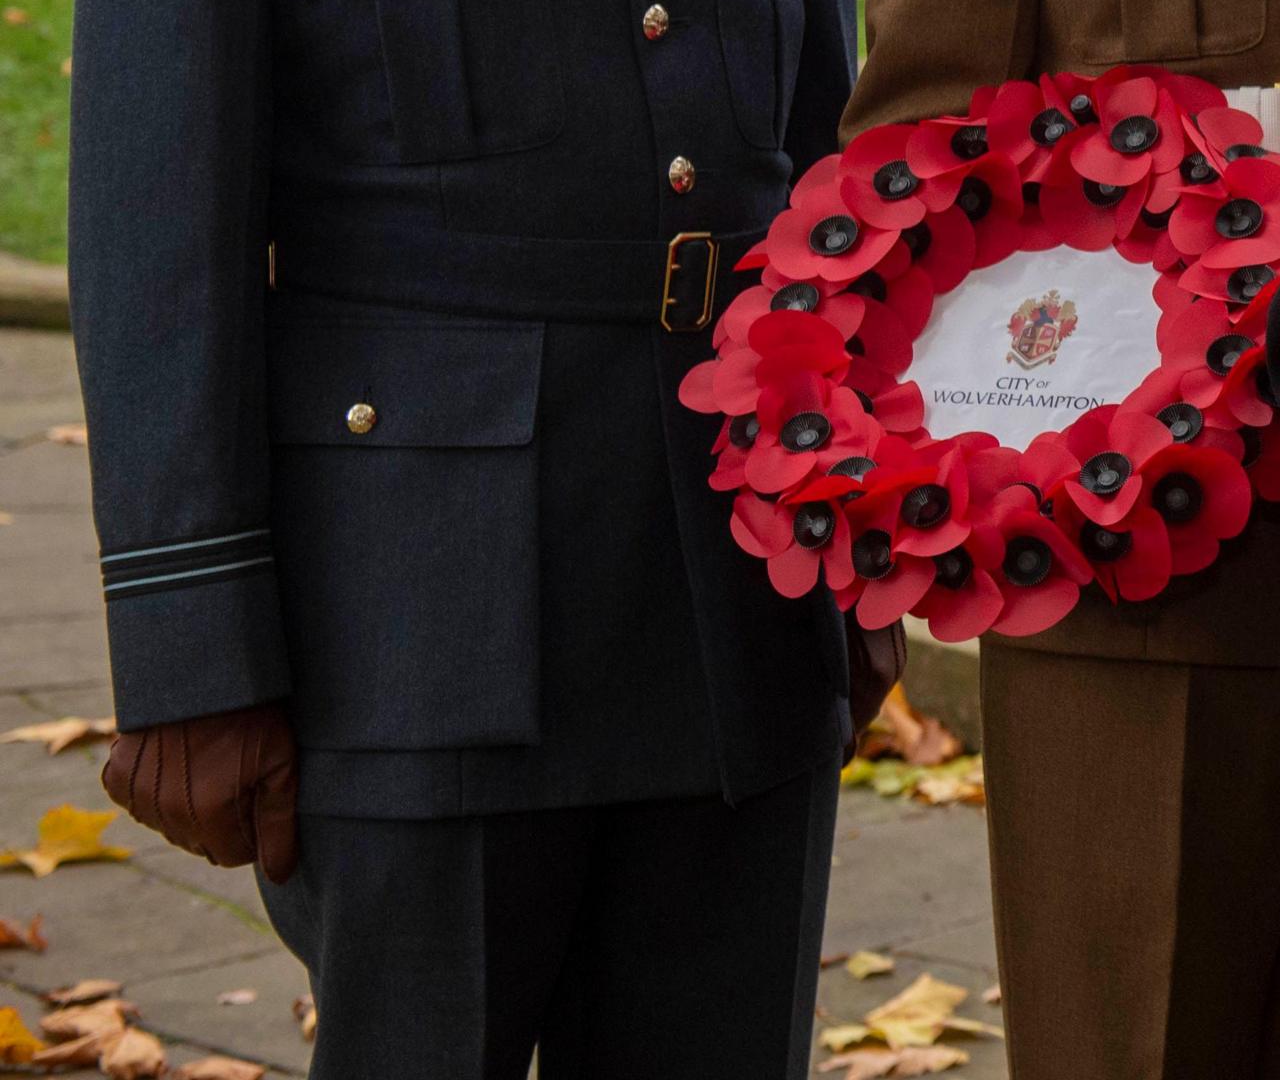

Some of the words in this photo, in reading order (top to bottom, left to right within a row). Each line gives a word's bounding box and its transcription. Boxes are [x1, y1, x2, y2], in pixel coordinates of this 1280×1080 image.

[996, 376, 1036, 390] CITY
[1036, 379, 1052, 389] OF
[933, 390, 1106, 410] WOLVERHAMPTON
